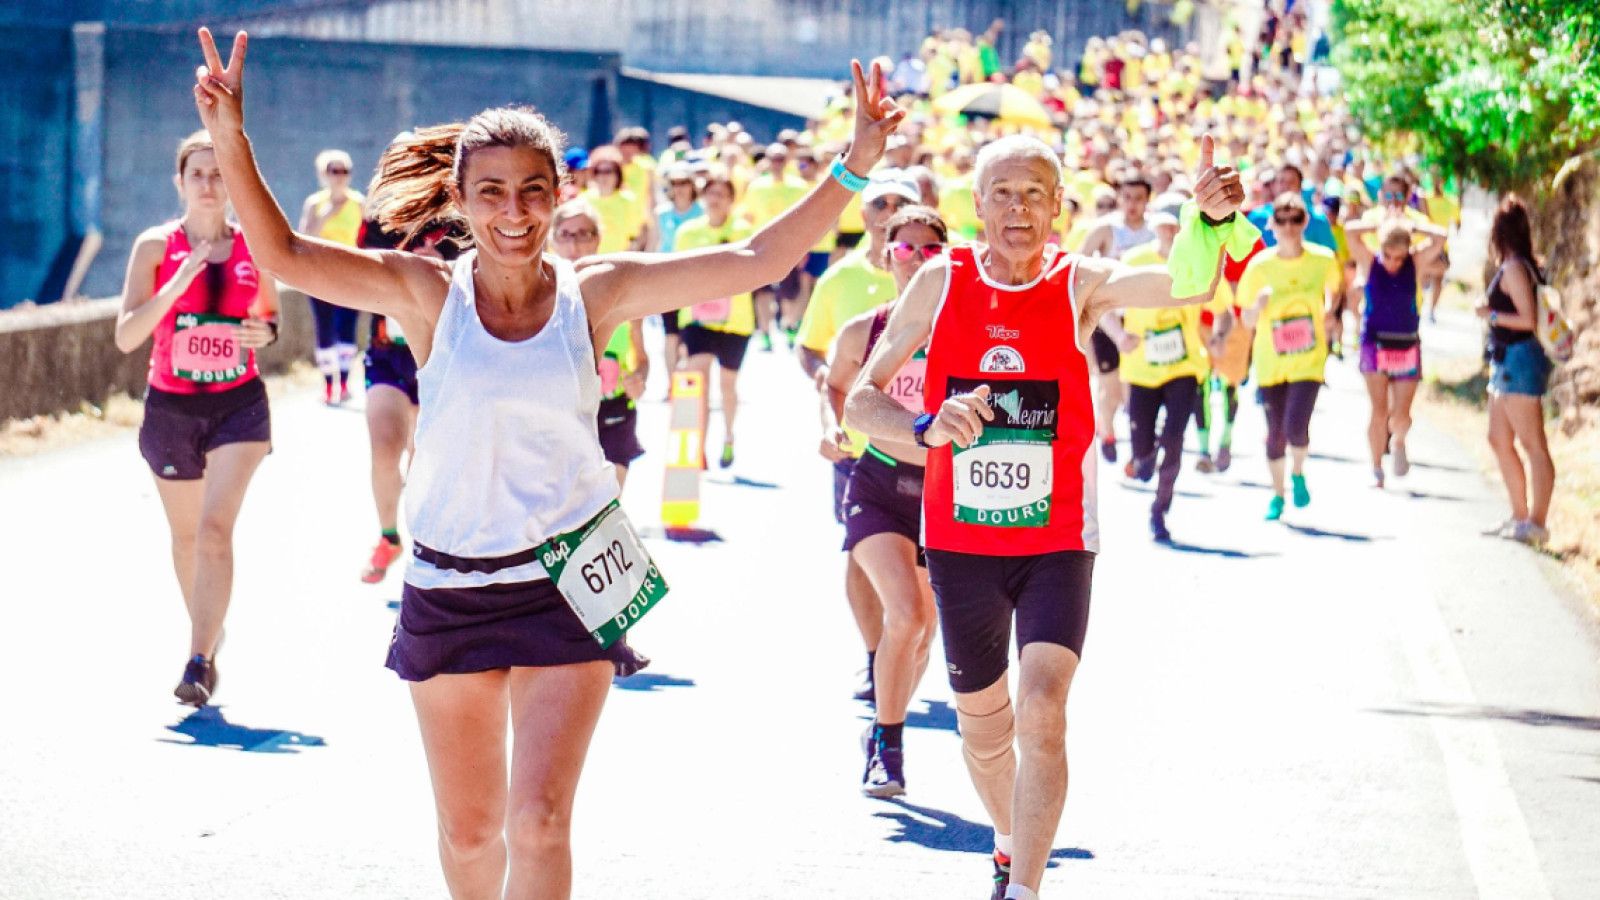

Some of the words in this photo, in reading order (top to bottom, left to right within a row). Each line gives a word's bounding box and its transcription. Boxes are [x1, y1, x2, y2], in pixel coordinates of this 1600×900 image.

[188, 336, 233, 357] 6056
[191, 364, 246, 381] DOURO
[890, 376, 924, 397] 124
[970, 460, 1031, 490] 6639
[977, 499, 1048, 523] DOURO
[581, 540, 634, 594] 6712
[615, 564, 658, 629] DOURO
